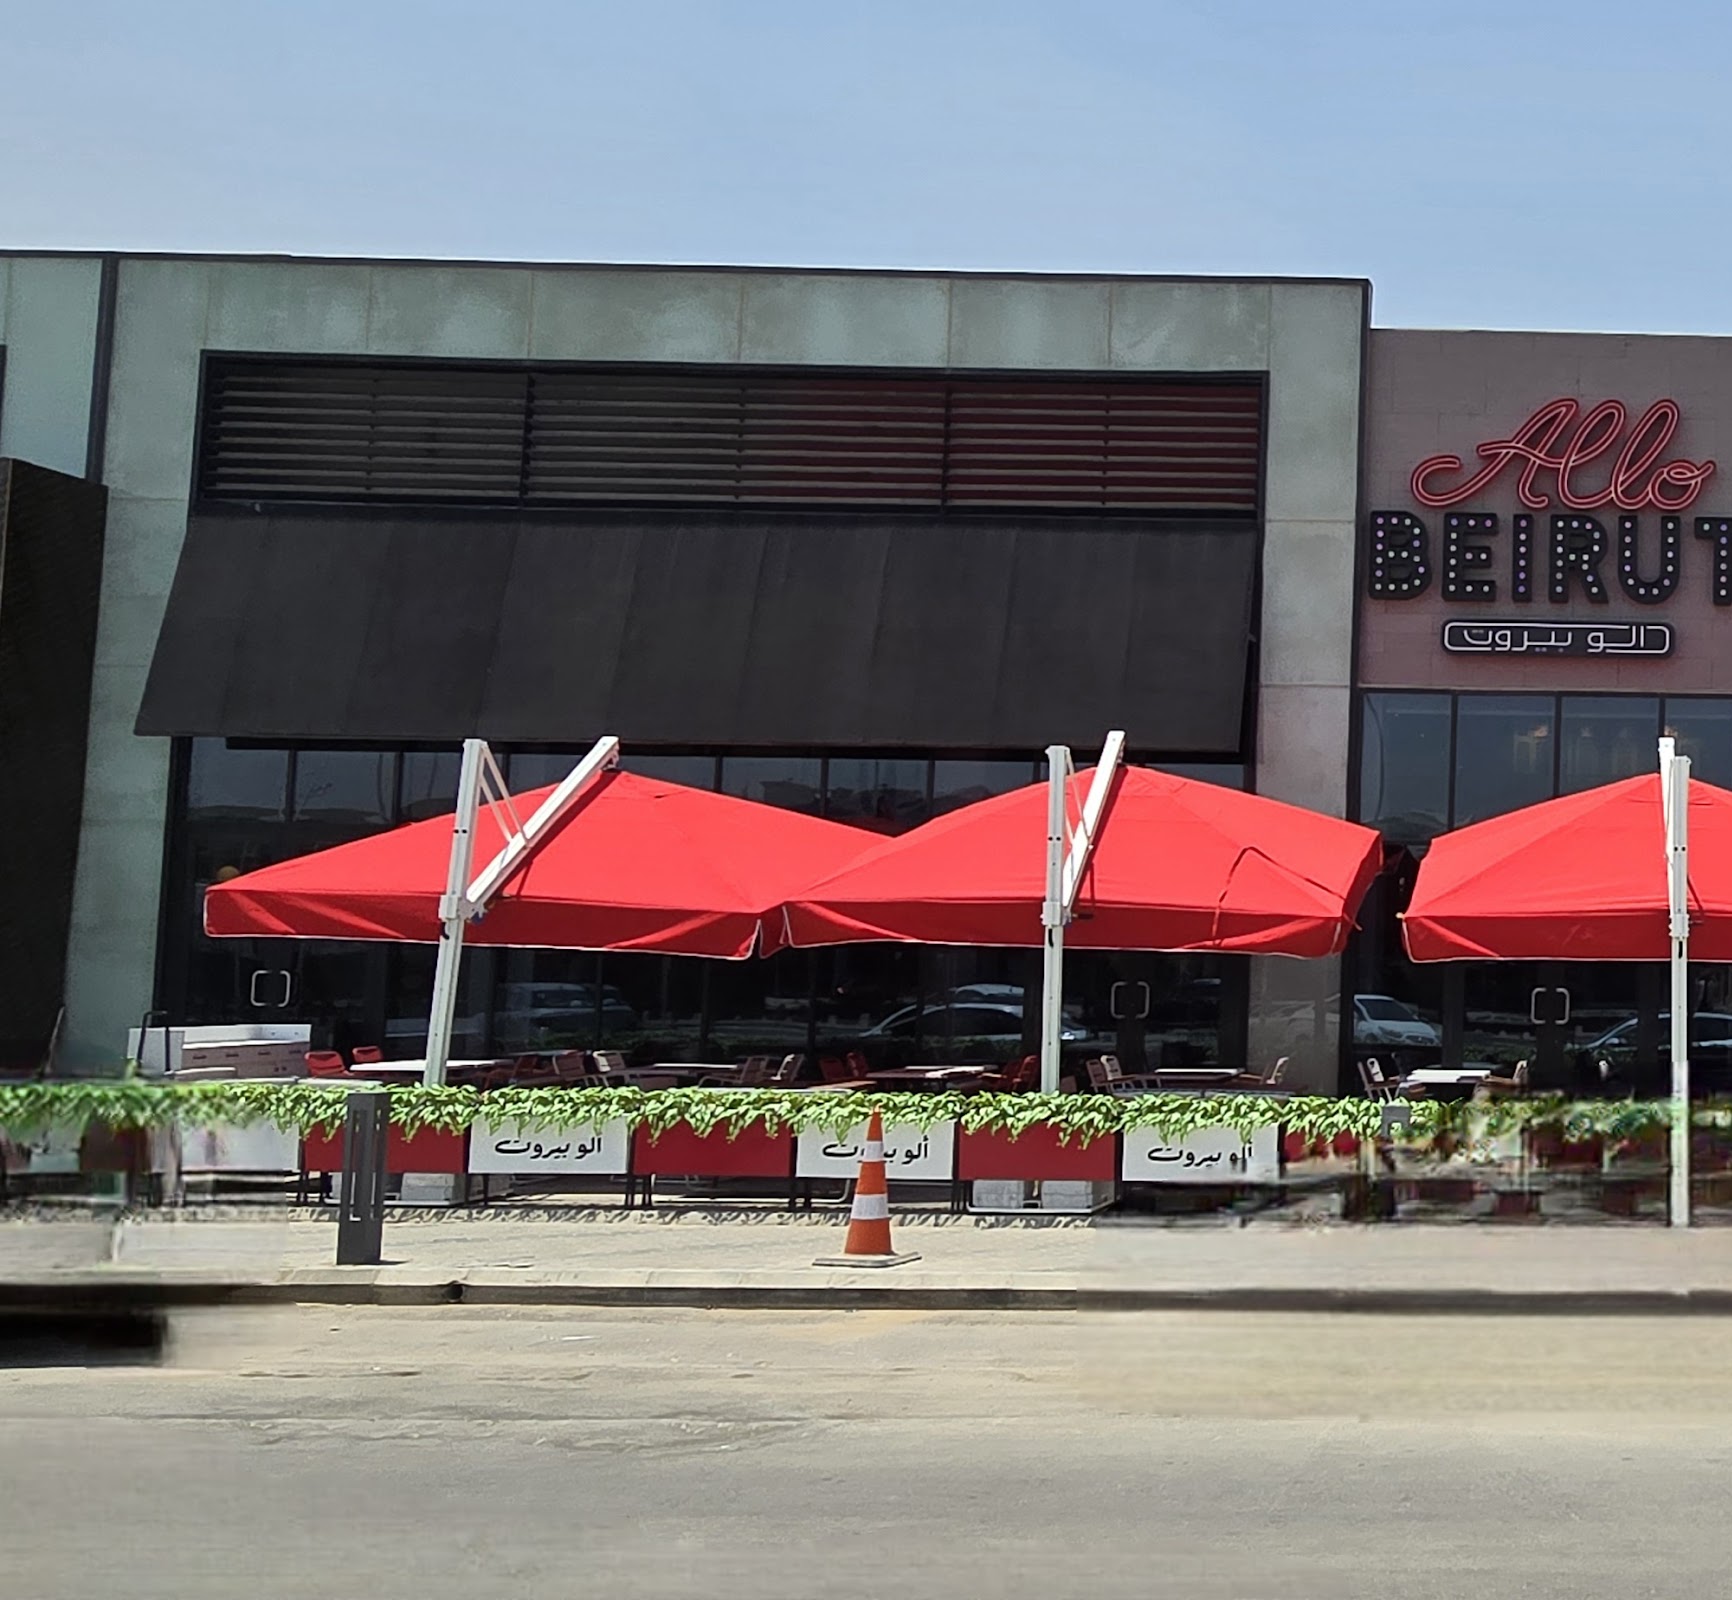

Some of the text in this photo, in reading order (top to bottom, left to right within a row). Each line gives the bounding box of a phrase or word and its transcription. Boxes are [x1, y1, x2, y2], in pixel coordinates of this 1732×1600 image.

[1411, 398, 1717, 510] Allo
[1463, 629, 1573, 653] بيروت
[494, 1140, 570, 1159] بيروت
[1147, 1147, 1222, 1167] بيروت
